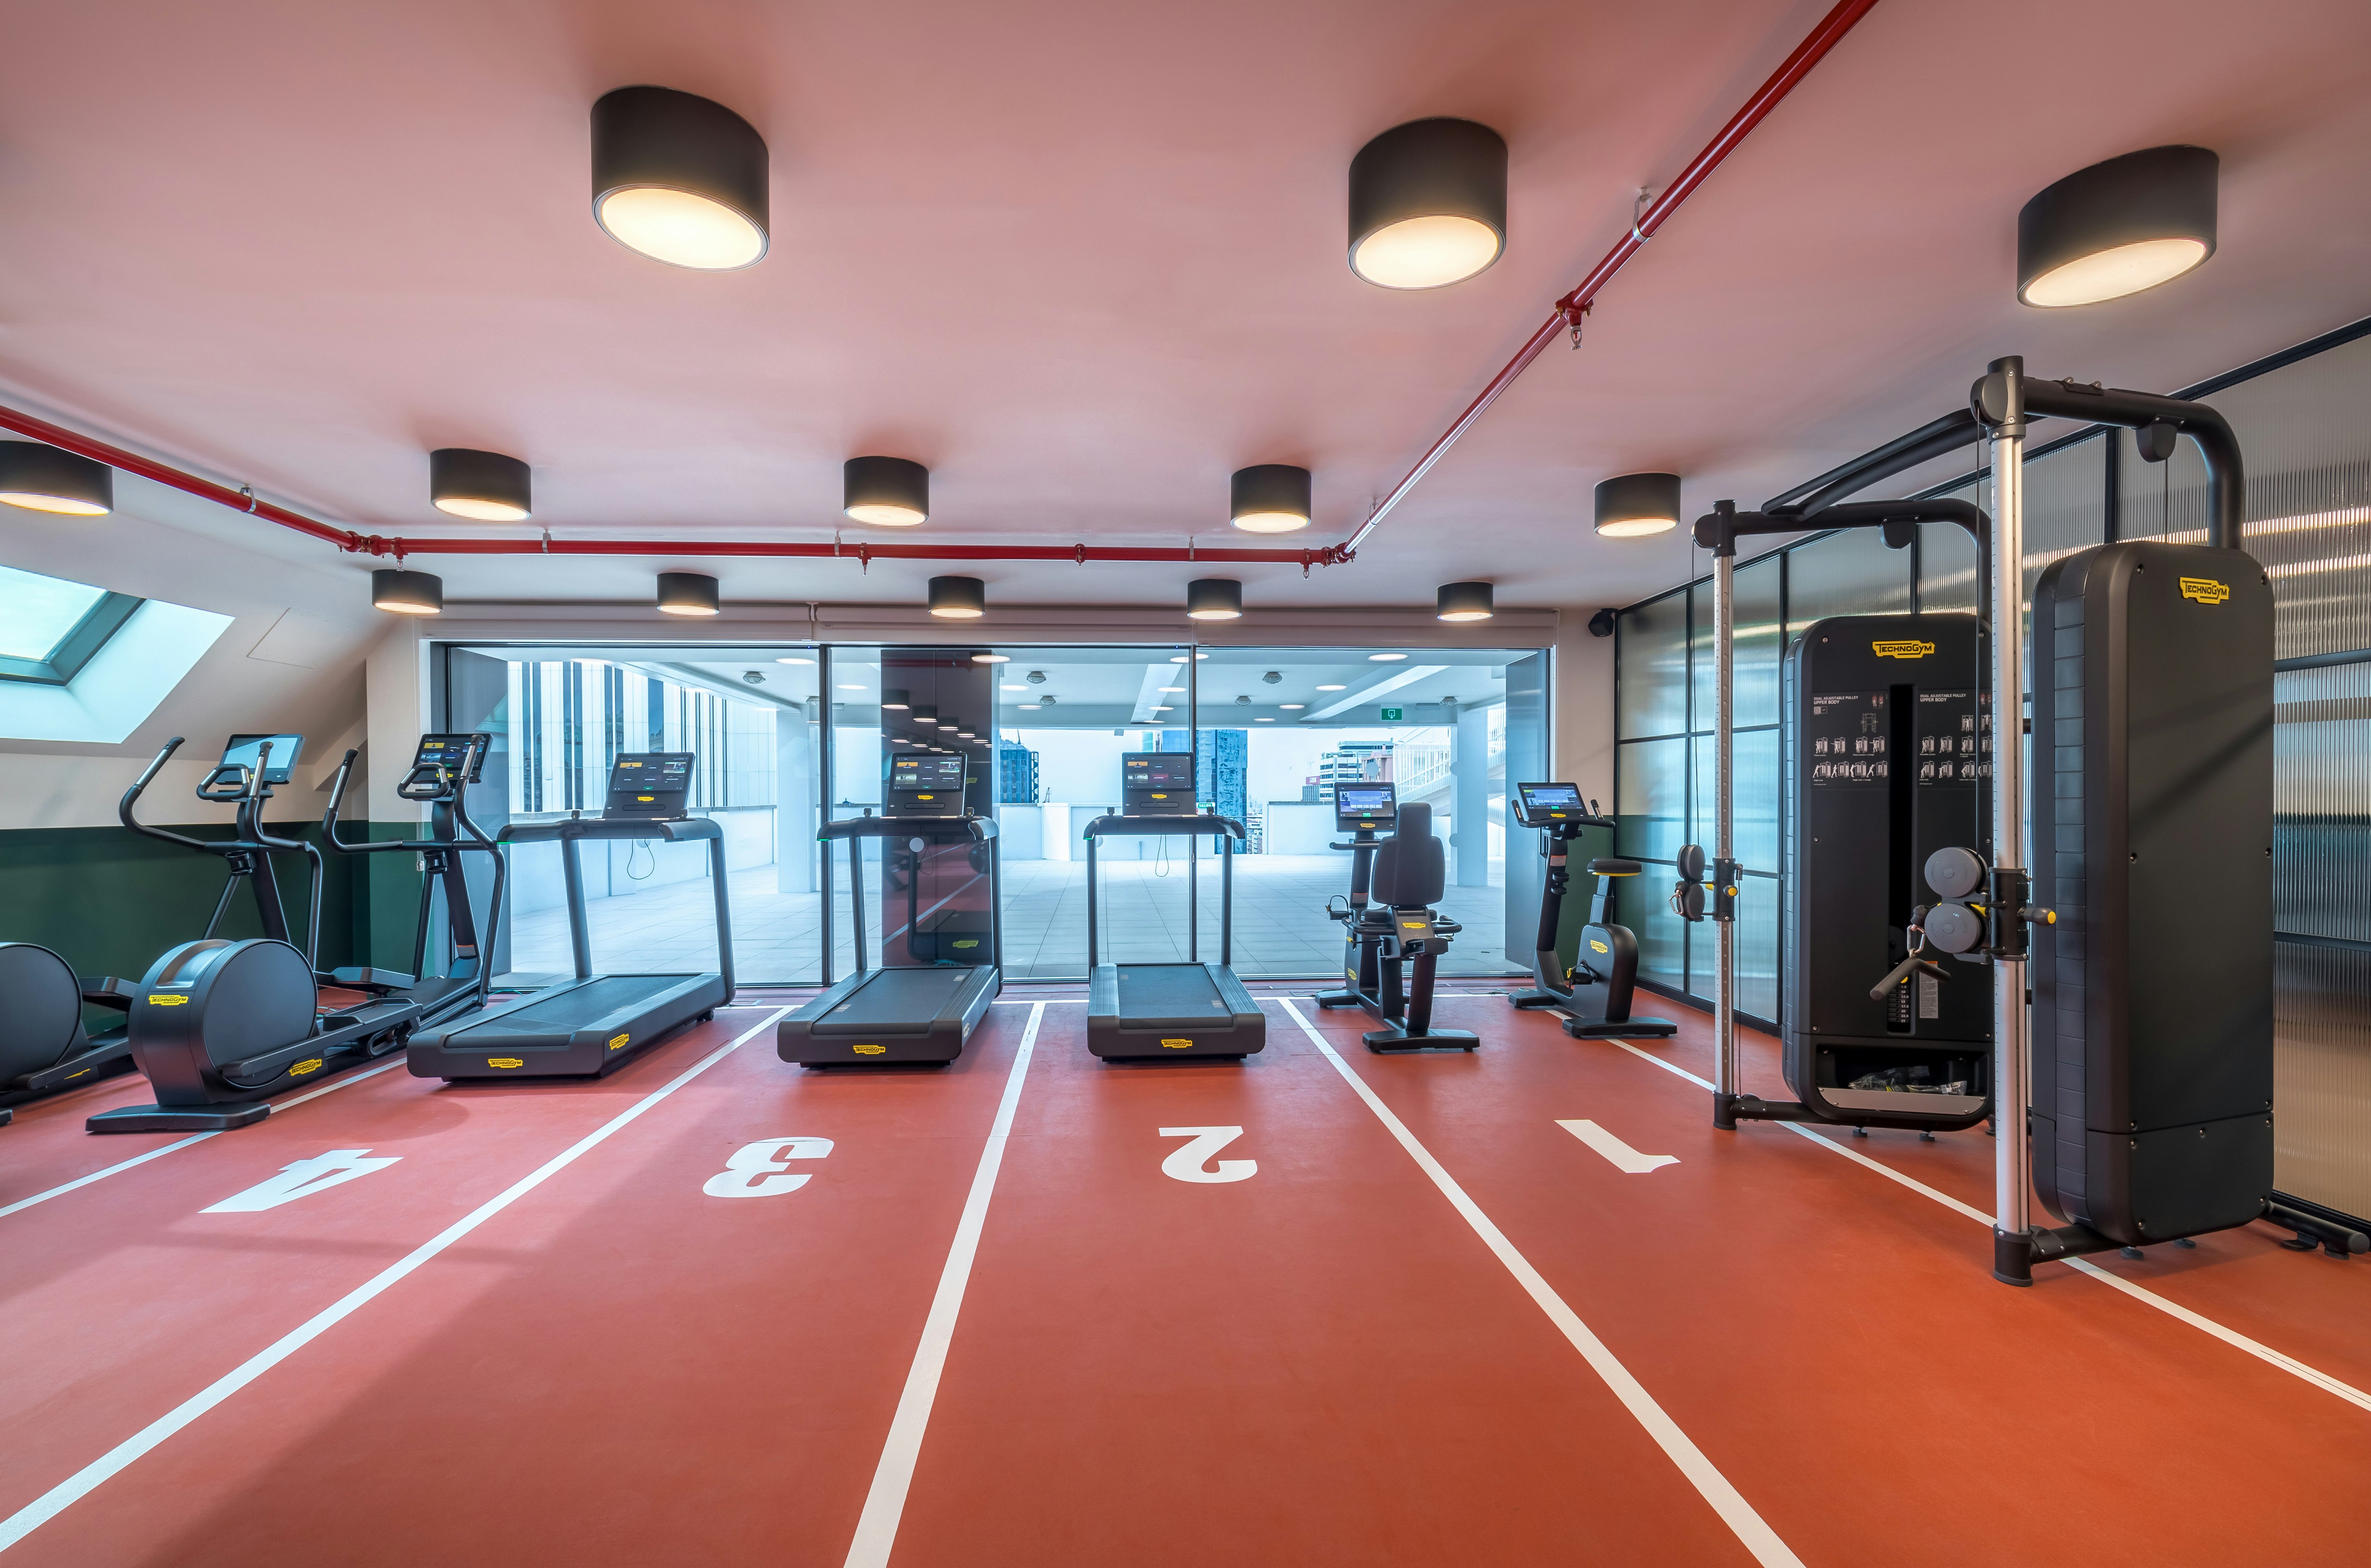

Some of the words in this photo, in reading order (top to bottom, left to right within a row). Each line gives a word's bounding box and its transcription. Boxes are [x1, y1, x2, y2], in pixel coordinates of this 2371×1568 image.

[292, 1061, 320, 1074] TECHNOGYM
[703, 1137, 834, 1198] 3
[1159, 1126, 1257, 1183] 2
[1555, 1120, 1681, 1173] 1
[197, 1149, 404, 1213] 4
